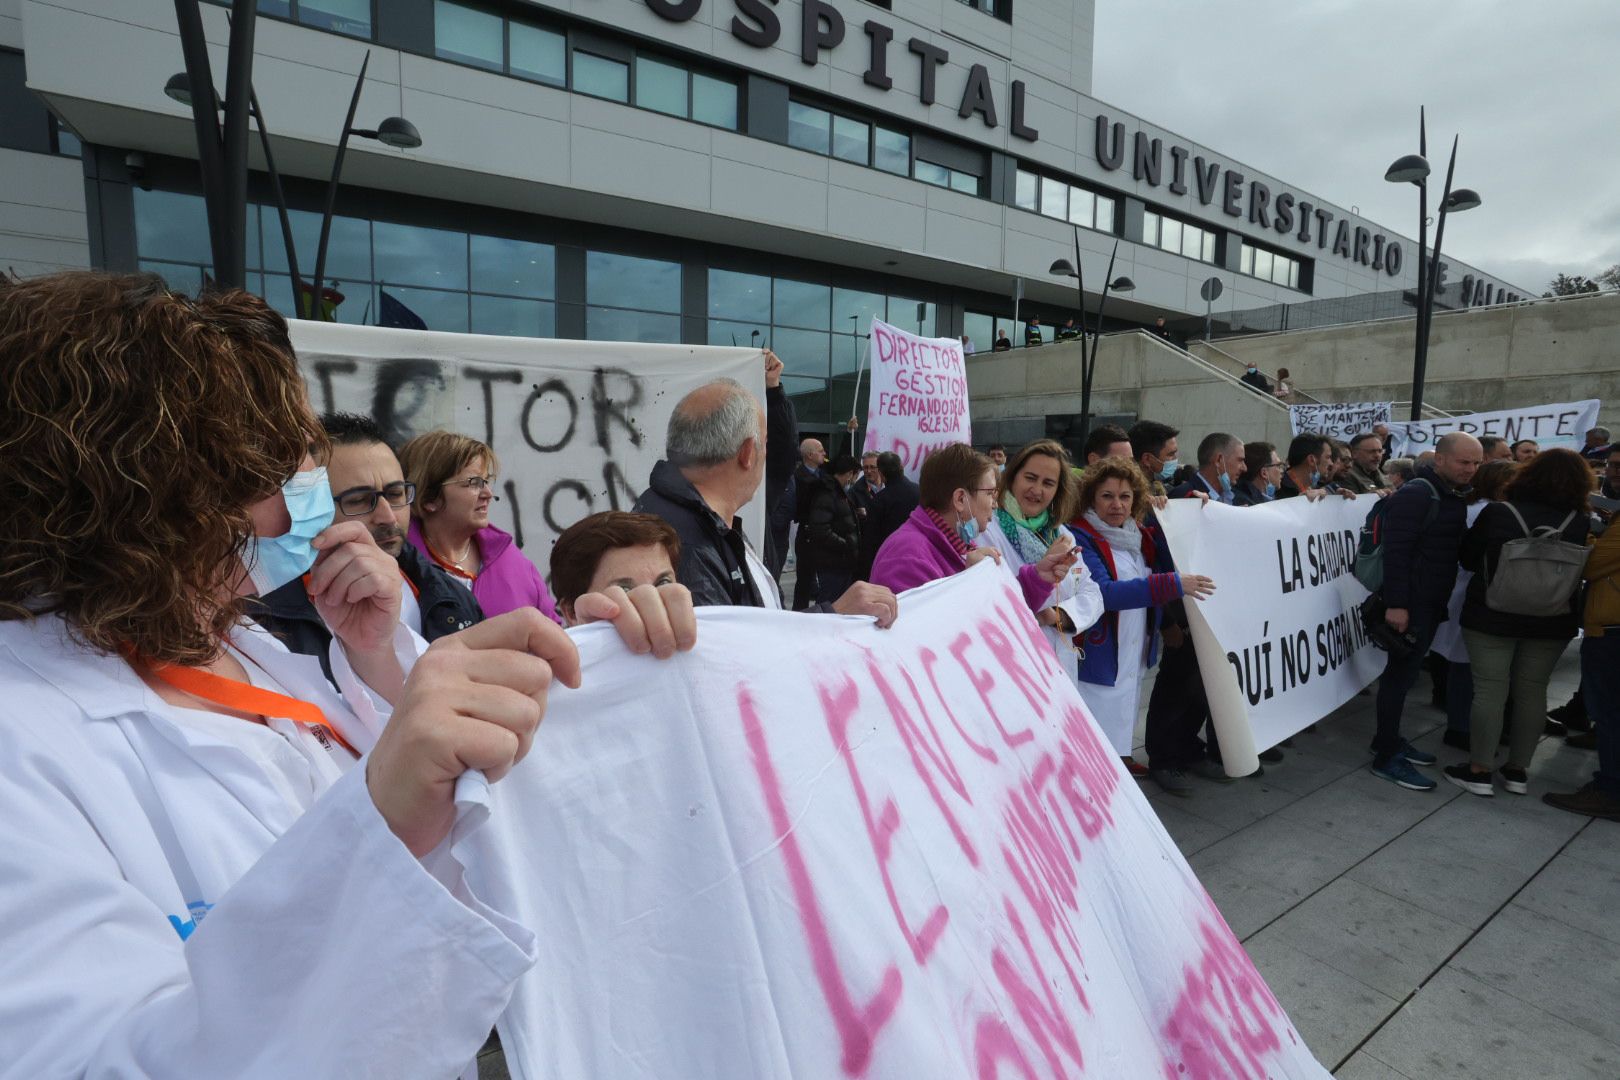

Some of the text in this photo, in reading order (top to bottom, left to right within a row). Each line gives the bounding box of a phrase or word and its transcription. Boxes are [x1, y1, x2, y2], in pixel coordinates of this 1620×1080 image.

[1095, 114, 1402, 277] UNIVERSITARIO
[875, 328, 961, 374] DIRECTOR
[879, 392, 949, 417] FERNANDO
[896, 370, 966, 396] GESTION
[918, 416, 960, 433] IGLESIA
[1276, 529, 1356, 594] LA SANIDAD
[1280, 629, 1311, 692] NO
[737, 582, 1061, 1077] LENCERIA
